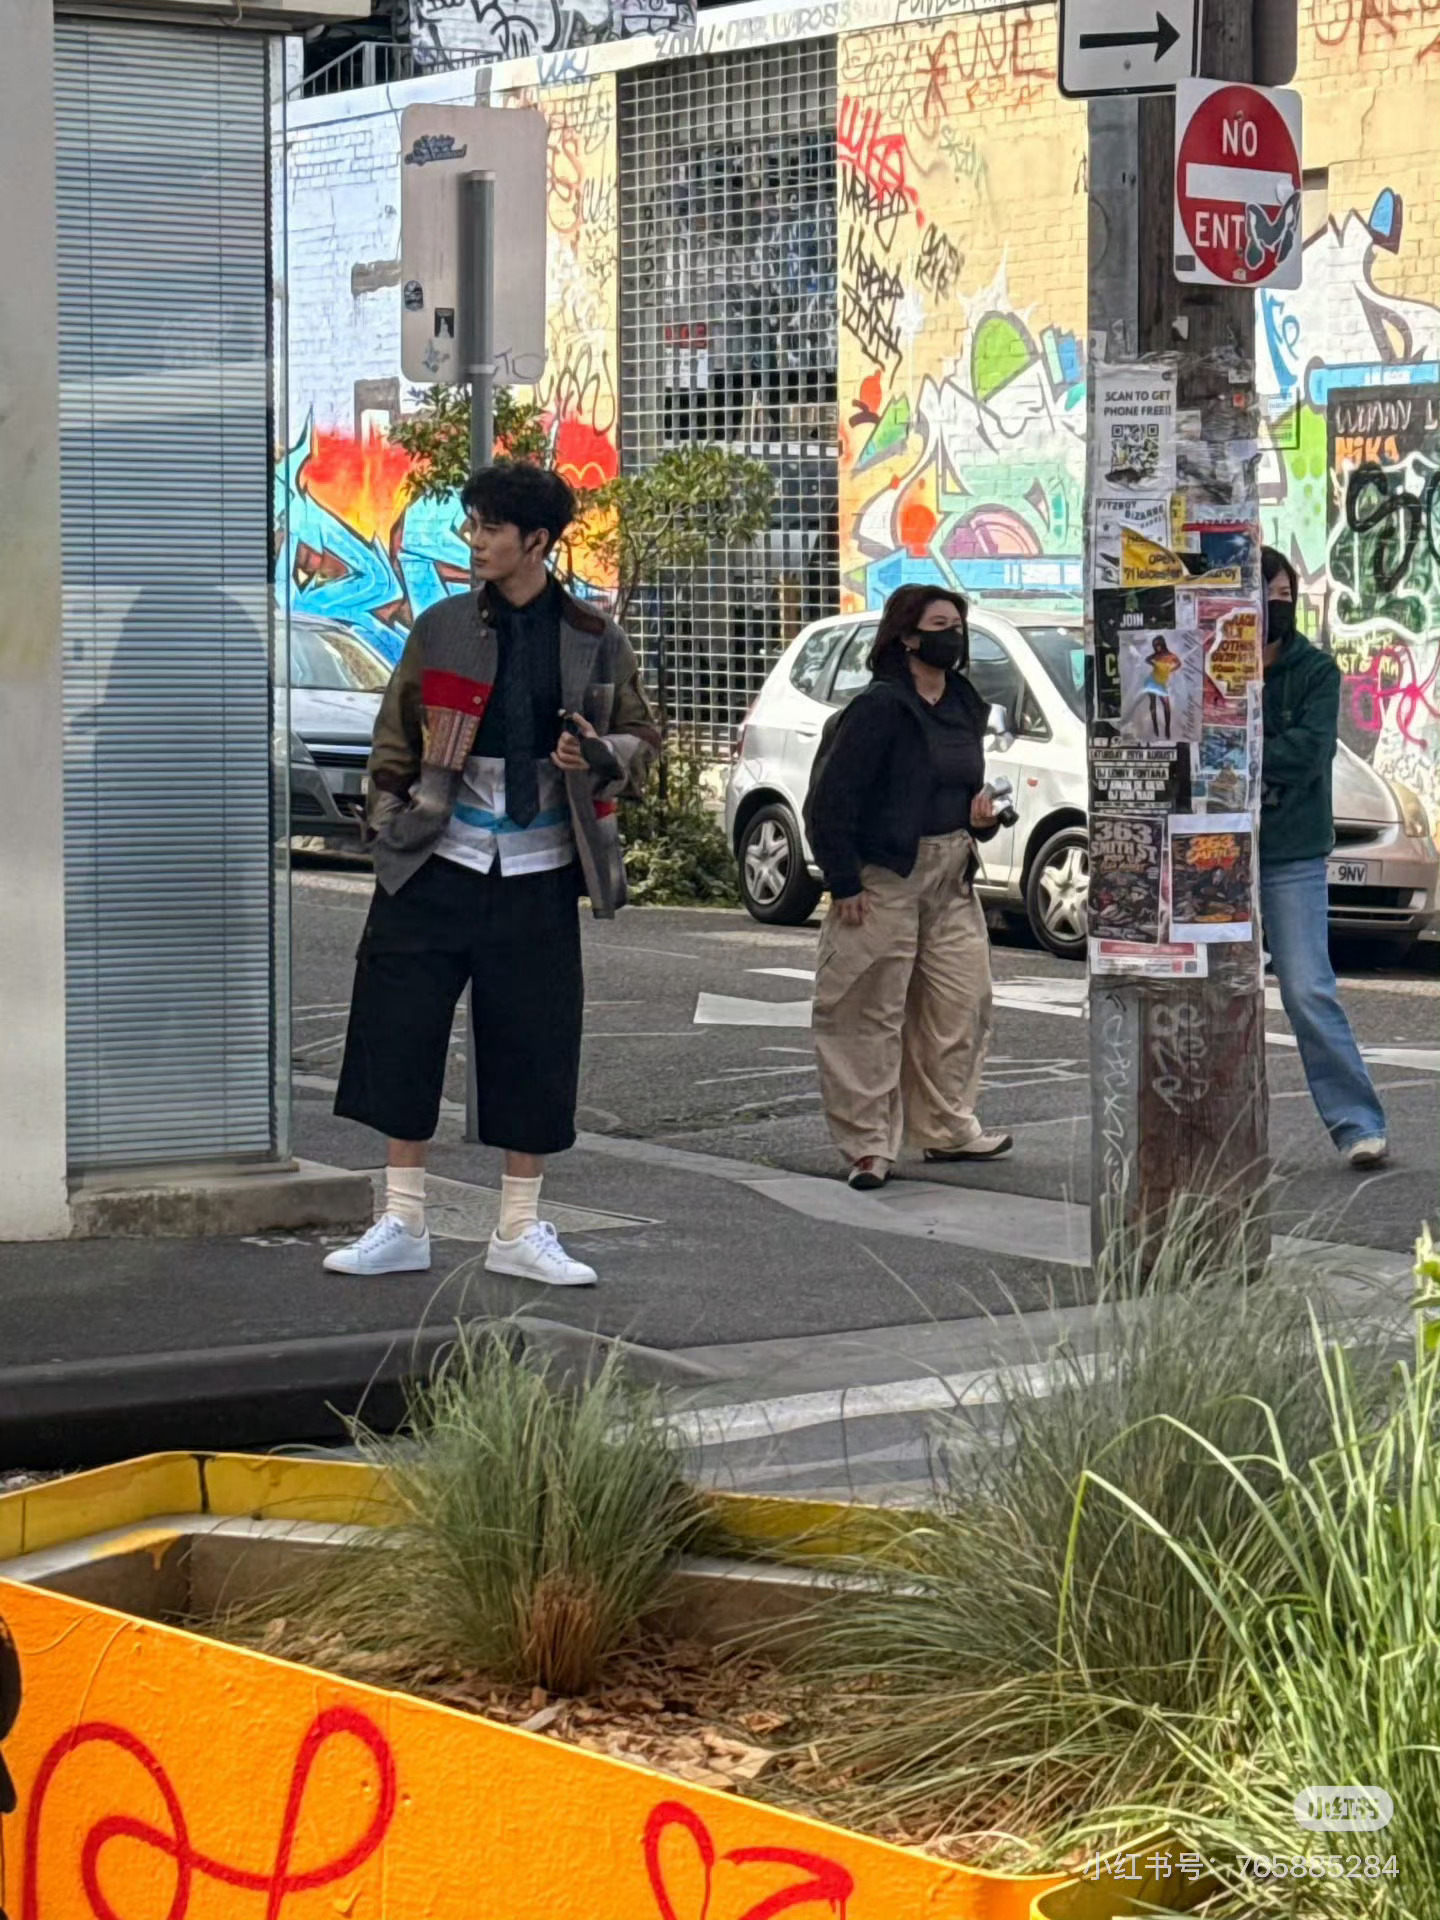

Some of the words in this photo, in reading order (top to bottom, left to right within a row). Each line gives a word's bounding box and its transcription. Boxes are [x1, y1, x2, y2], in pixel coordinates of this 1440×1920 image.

[1222, 119, 1258, 157] NO
[1195, 211, 1246, 249] ENT
[1105, 391, 1133, 402] SCAN
[1135, 390, 1149, 401] TO
[1152, 390, 1171, 401] GET
[1104, 406, 1139, 416] PHONE
[1120, 613, 1144, 627] JOIN
[1095, 821, 1153, 844] 363
[1090, 841, 1135, 858] SMITH
[1136, 844, 1158, 864] ST
[1338, 866, 1365, 882] 9NV
